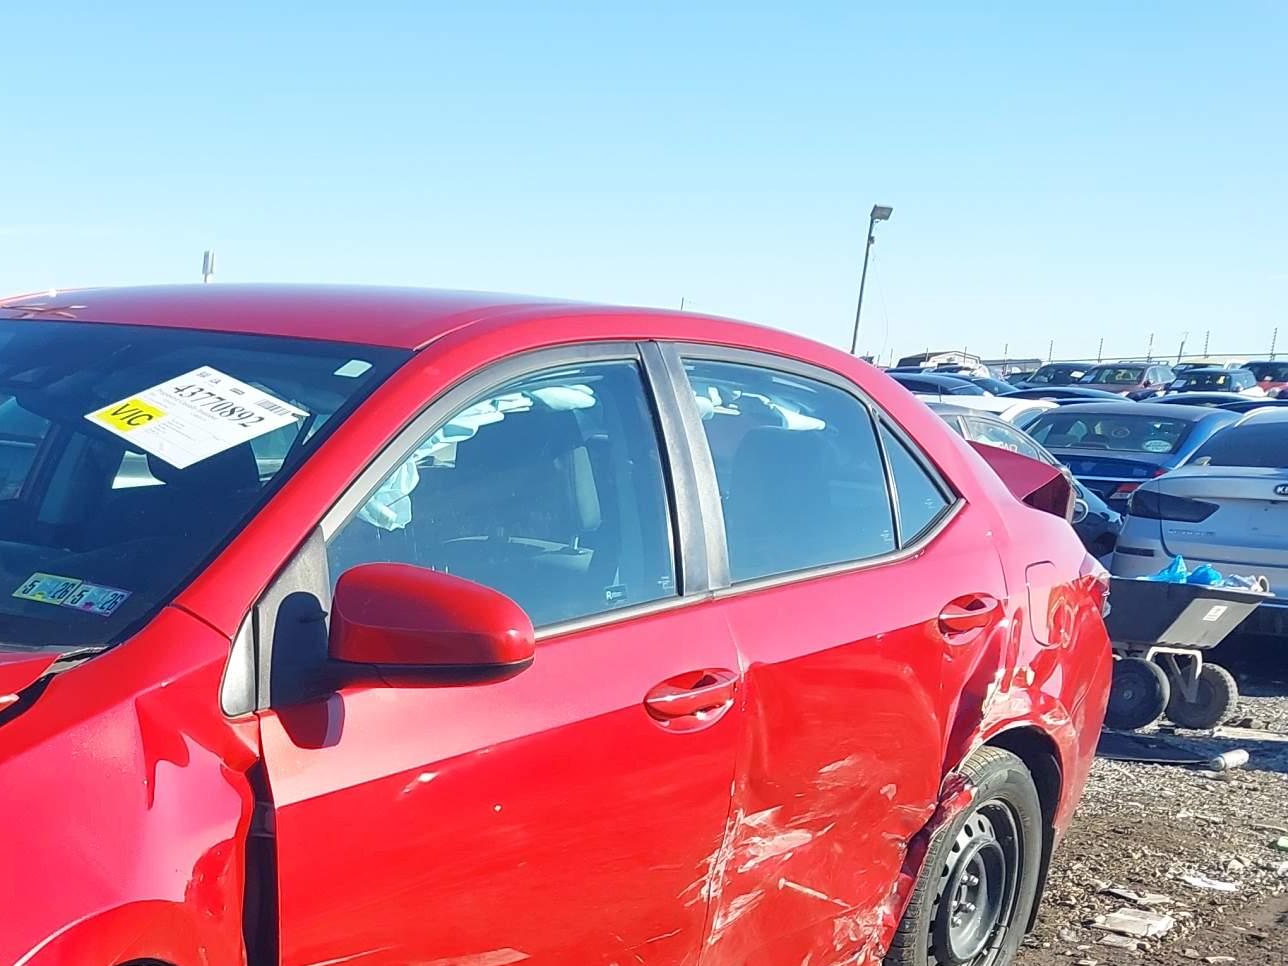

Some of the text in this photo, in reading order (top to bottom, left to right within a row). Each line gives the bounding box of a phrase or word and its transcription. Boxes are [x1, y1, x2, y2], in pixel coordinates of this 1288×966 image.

[110, 403, 154, 427] VIC
[172, 382, 265, 428] 43770892
[51, 582, 76, 600] 26
[98, 593, 125, 611] 26
